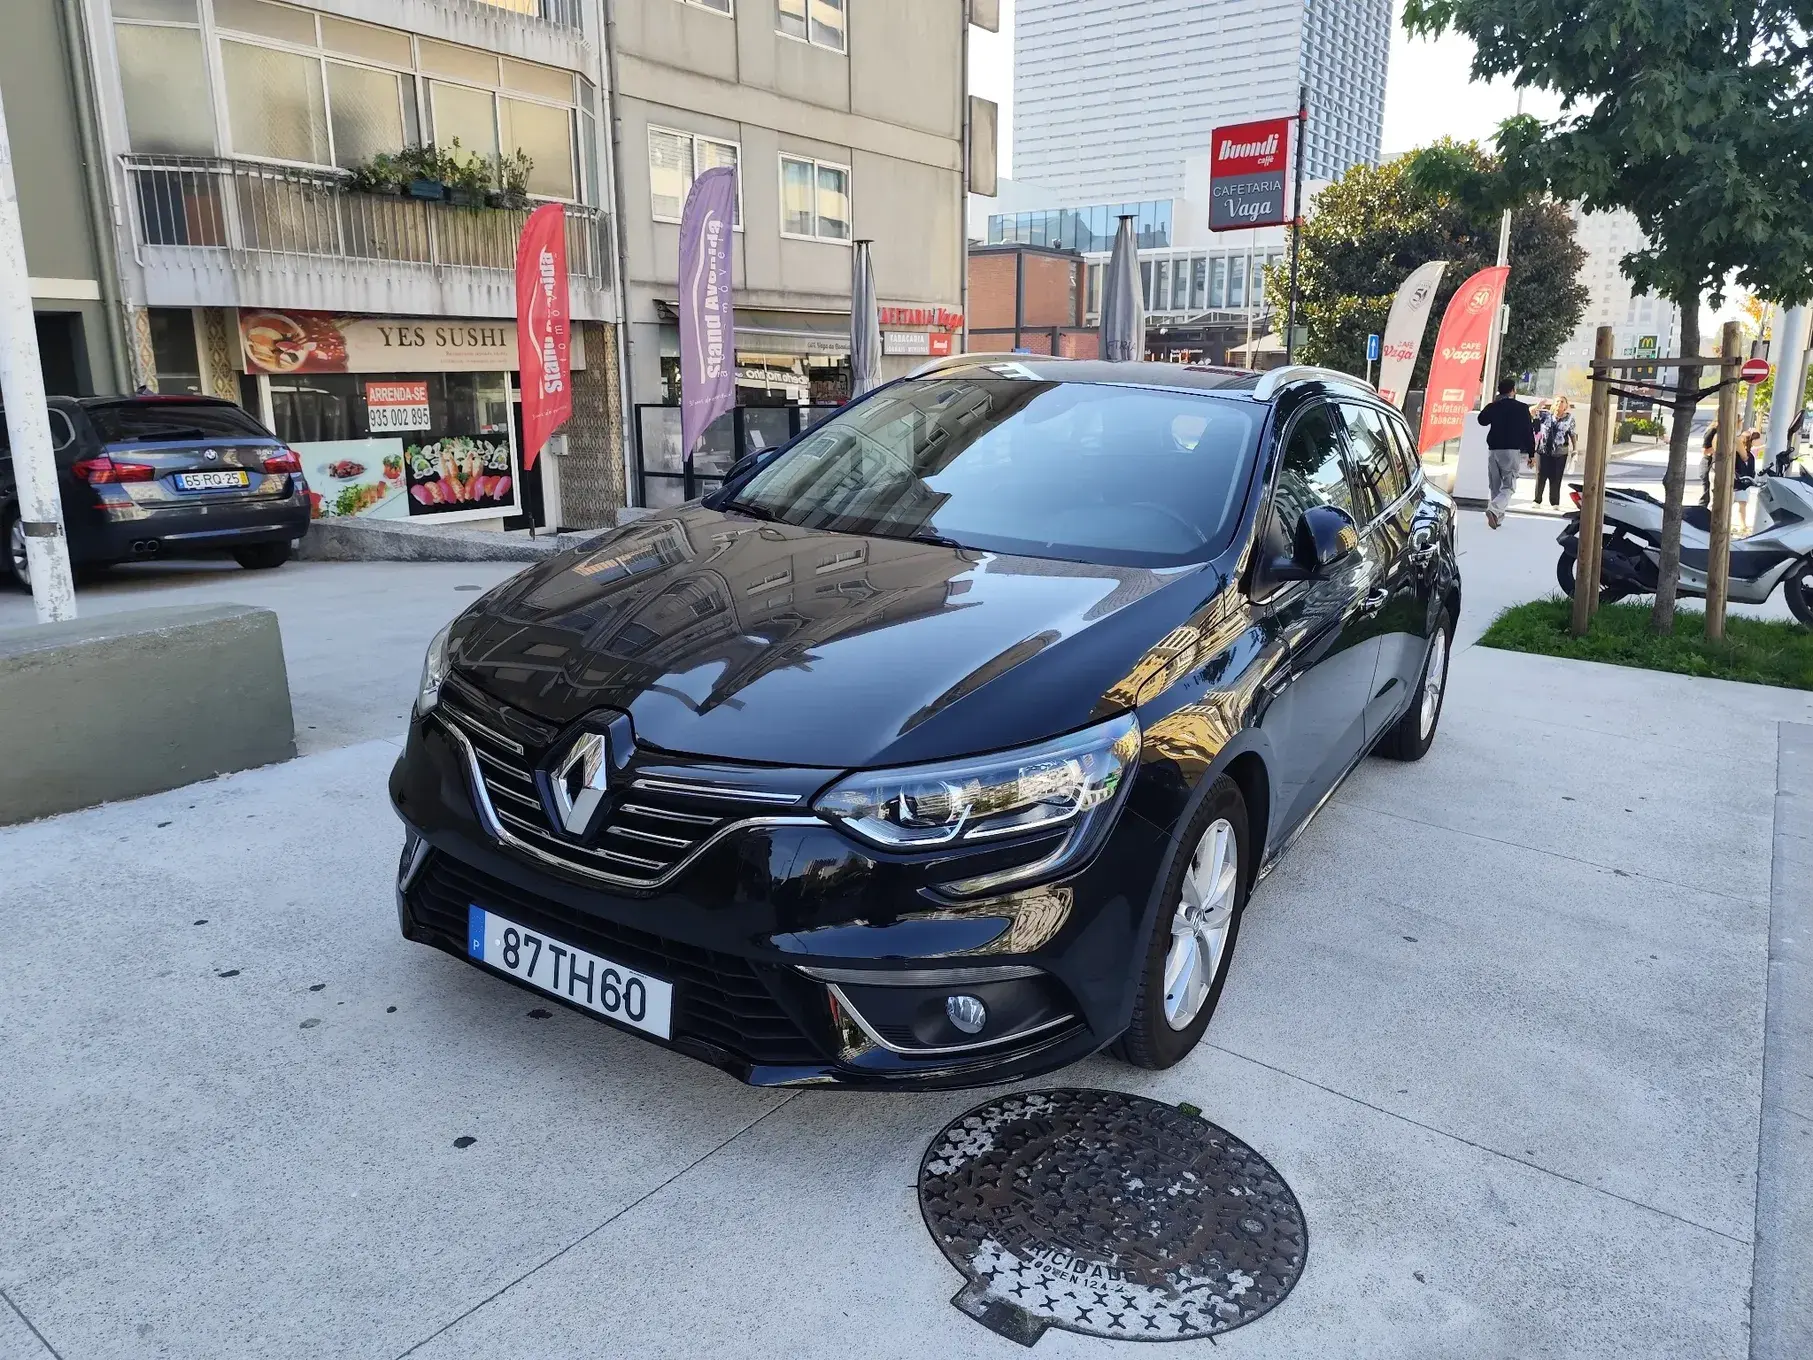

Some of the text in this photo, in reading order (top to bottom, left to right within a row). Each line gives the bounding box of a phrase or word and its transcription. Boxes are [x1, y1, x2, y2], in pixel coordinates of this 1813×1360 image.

[1218, 133, 1279, 161] Buondi
[1213, 180, 1282, 197] CAFETARIA
[1224, 197, 1273, 222] Vaga
[881, 307, 933, 324] AFETARIA
[377, 327, 507, 347] YES SUSHI
[705, 314, 722, 379] Stand
[1441, 348, 1483, 364] Vaga
[369, 387, 427, 401] ARRENDA-SE
[370, 407, 429, 427] 935 002 895
[473, 938, 480, 951] P
[502, 927, 647, 1022] 87TH60
